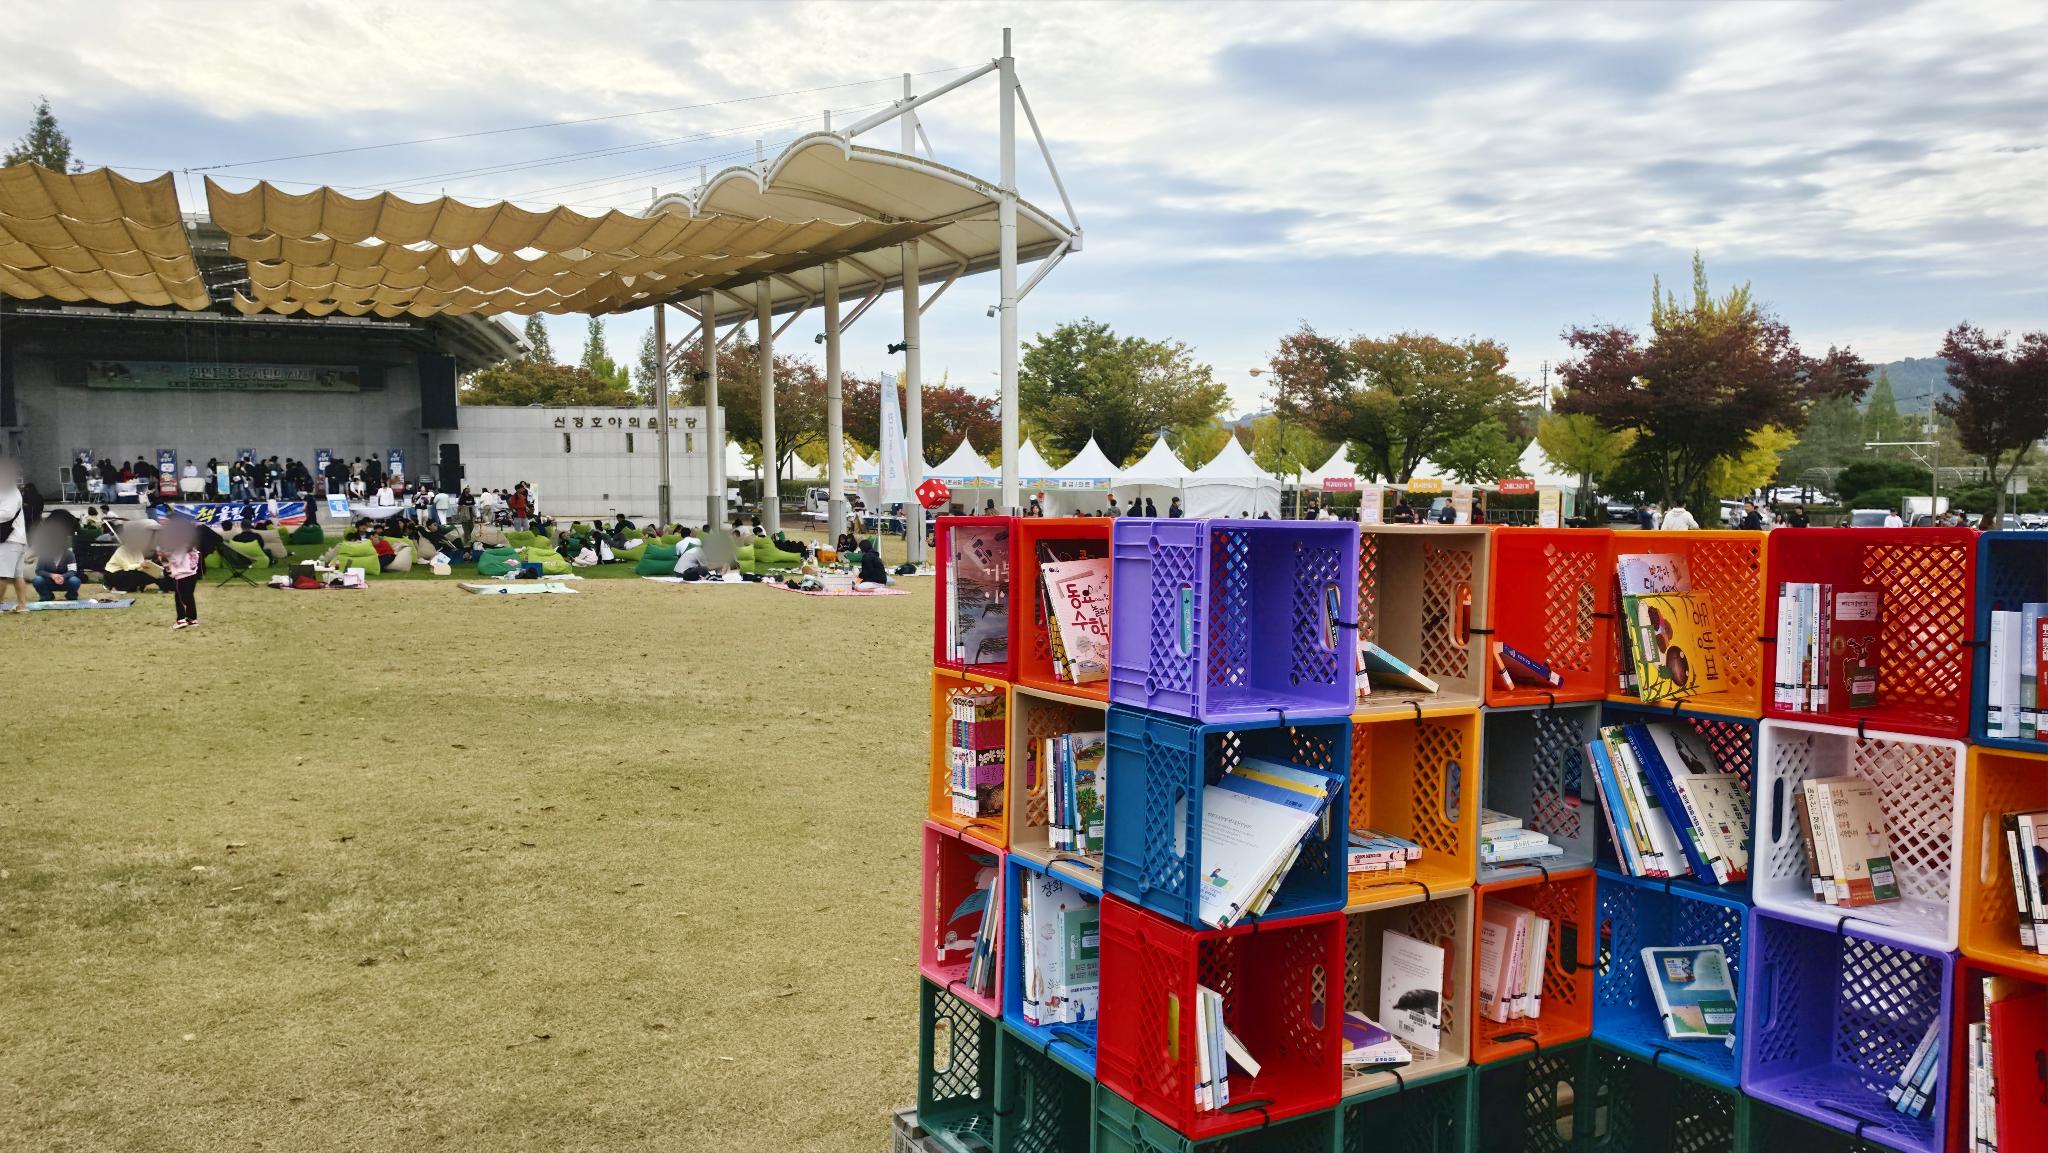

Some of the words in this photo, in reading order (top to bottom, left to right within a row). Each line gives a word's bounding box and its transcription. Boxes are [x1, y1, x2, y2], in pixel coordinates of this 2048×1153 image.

[554, 416, 698, 429] 신정호야외음악당
[195, 506, 216, 523] 책
[1066, 584, 1095, 609] 동요
[1071, 610, 1110, 643] 수학
